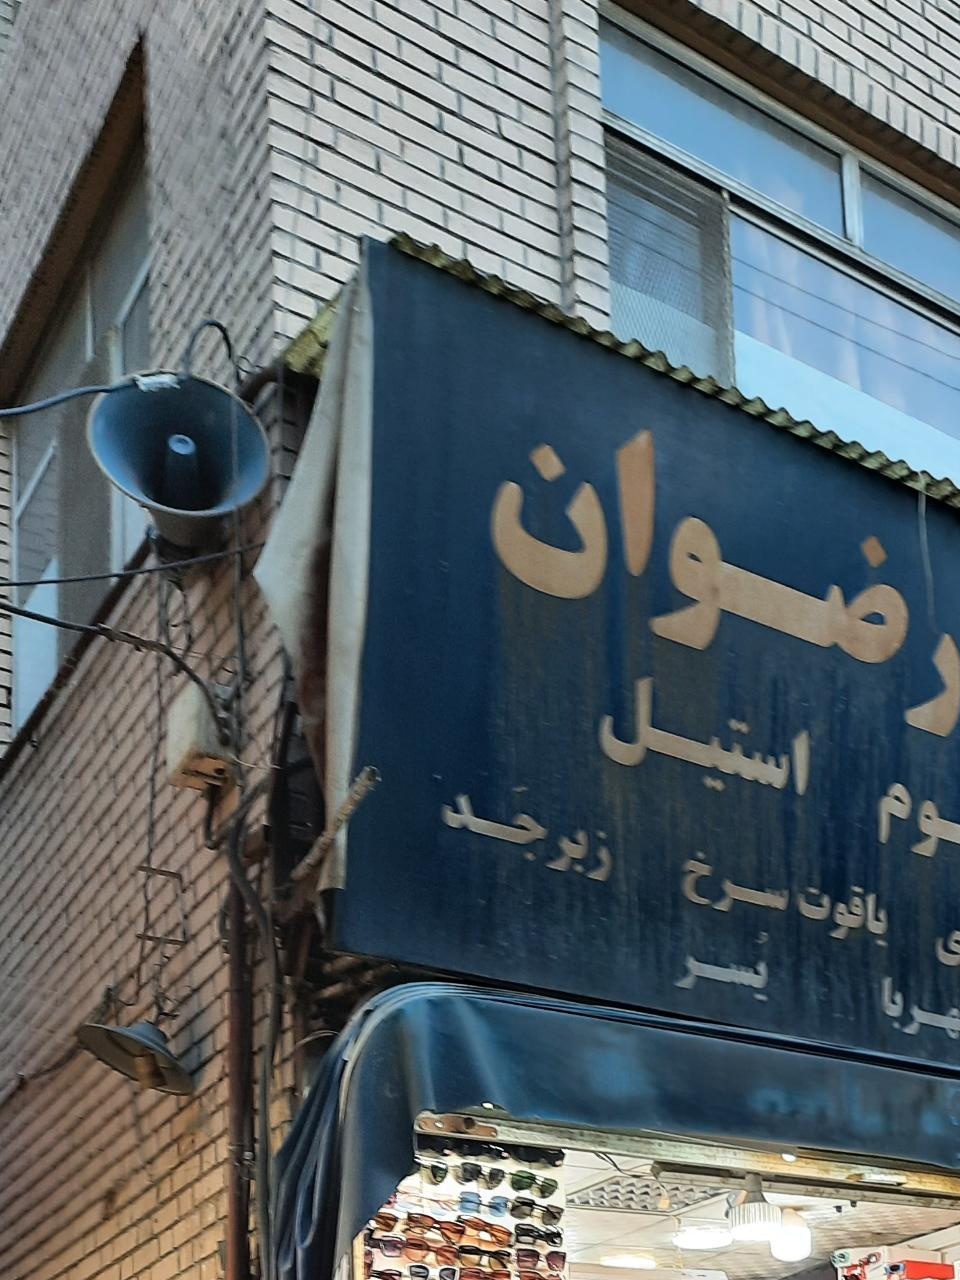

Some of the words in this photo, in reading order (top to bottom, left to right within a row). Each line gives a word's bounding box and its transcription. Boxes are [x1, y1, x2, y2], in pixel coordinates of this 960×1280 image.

[601, 677, 810, 795] استیل
[682, 851, 789, 912] سرخ
[798, 885, 888, 947] یاقوت
